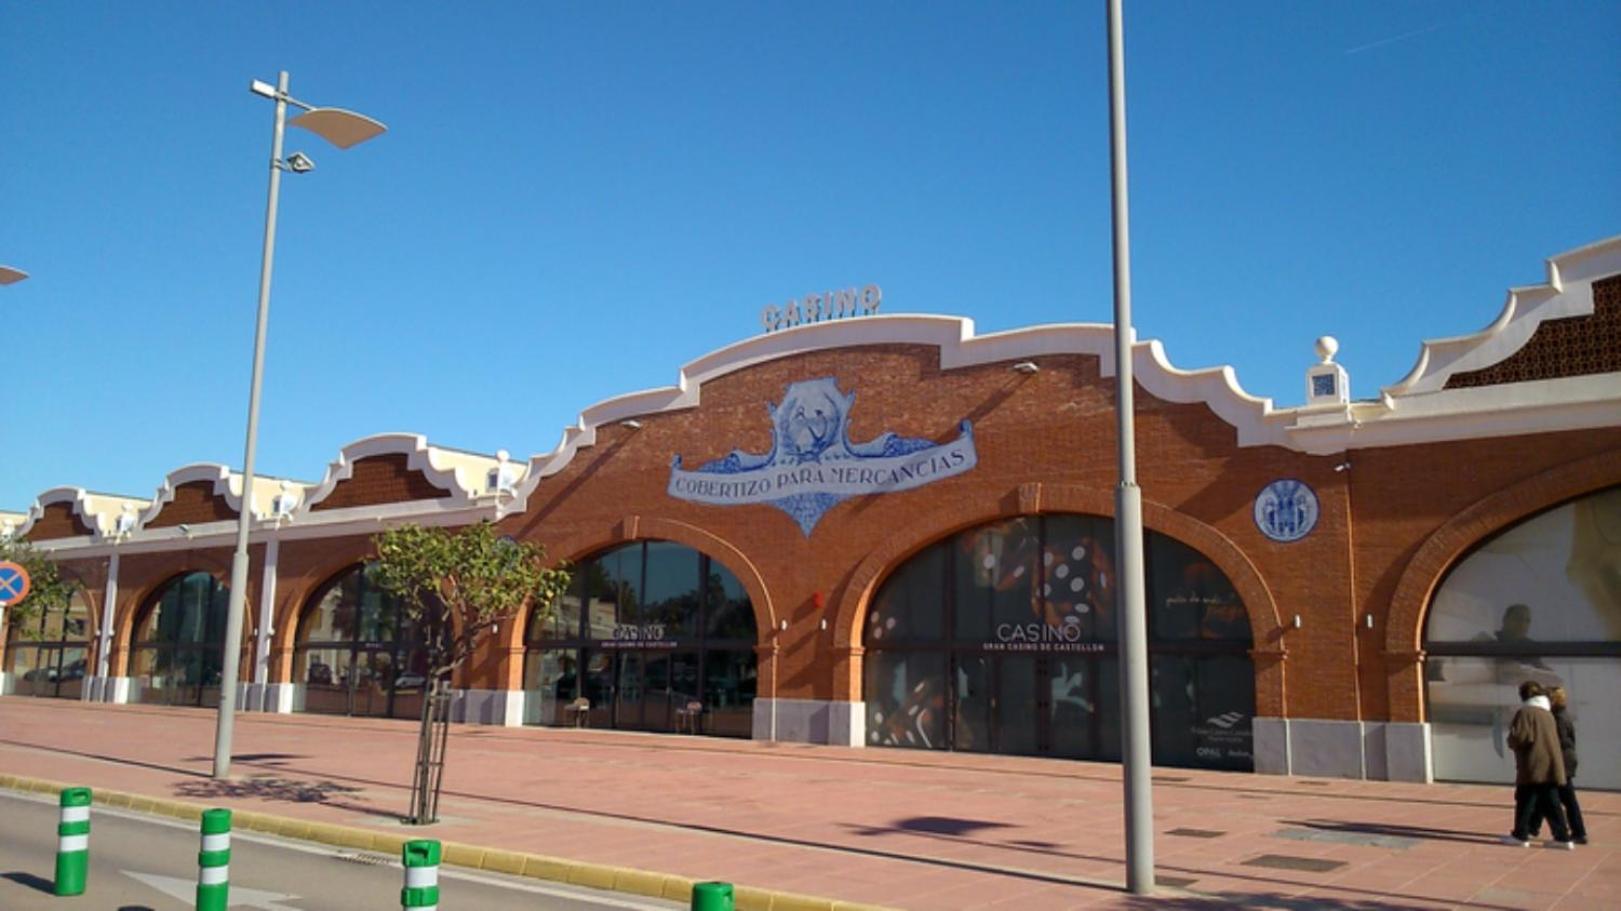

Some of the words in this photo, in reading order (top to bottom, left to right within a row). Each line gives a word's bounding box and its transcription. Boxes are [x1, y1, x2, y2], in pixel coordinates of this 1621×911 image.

[760, 284, 882, 329] CASINO
[675, 476, 771, 498] COBERTIZO
[777, 467, 825, 489] PARA
[831, 449, 966, 486] MERCANCIAS
[983, 643, 1006, 652] GRAN
[1007, 643, 1038, 652] CASINO
[1040, 643, 1052, 652] DE
[997, 622, 1081, 643] CASINO
